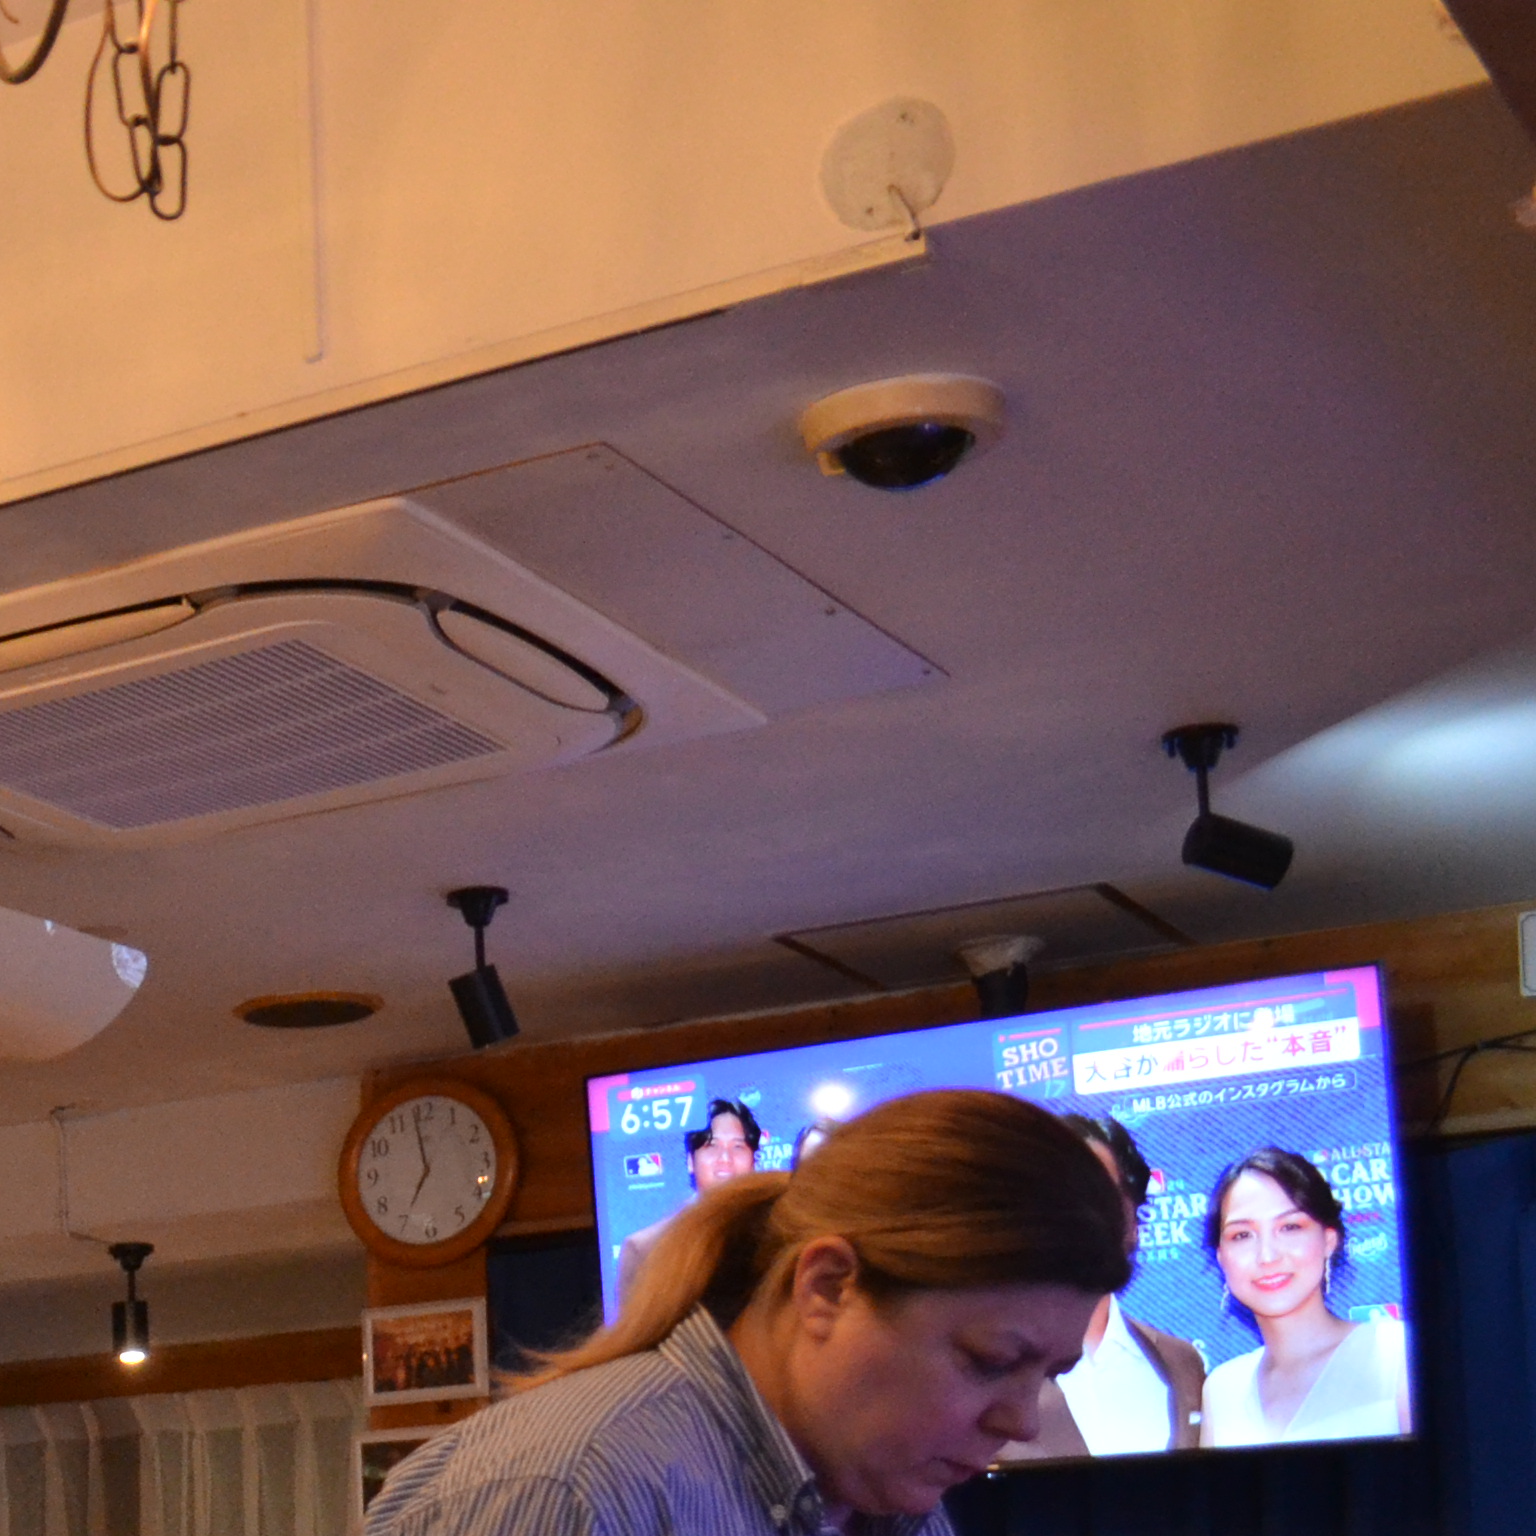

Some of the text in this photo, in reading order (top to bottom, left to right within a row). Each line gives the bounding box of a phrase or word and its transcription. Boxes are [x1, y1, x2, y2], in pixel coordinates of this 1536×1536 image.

[1132, 1002, 1296, 1043] 地元ラジオに場
[1002, 1037, 1058, 1068] SHO
[996, 1056, 1069, 1089] TIME
[1132, 1073, 1346, 1114] MLB公式のインスタグラムから
[620, 1095, 694, 1135] 6:57
[1136, 1193, 1208, 1222] STAR
